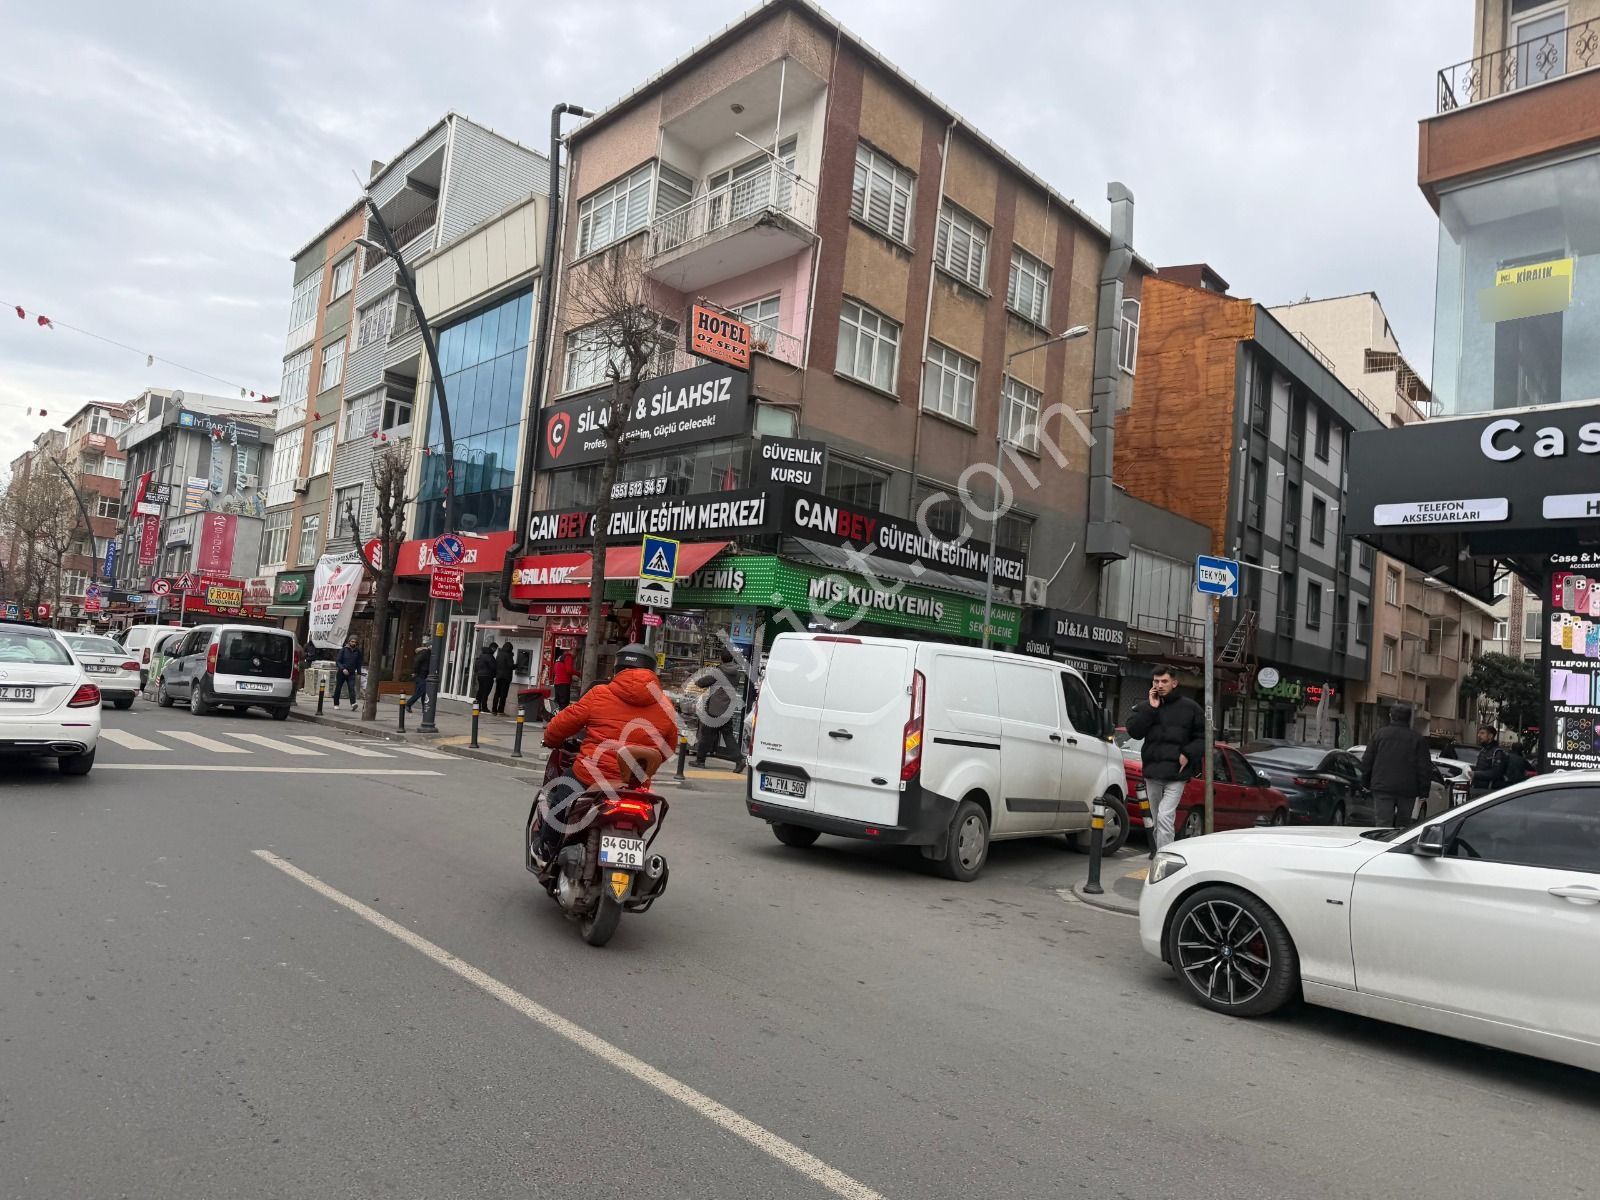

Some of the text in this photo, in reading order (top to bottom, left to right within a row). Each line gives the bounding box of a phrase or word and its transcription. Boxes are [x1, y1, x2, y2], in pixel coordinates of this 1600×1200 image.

[698, 312, 747, 345] HOTEL
[716, 340, 746, 356] SEFA
[635, 397, 647, 420] &
[650, 376, 732, 417] SİLAHSIZ
[653, 422, 677, 438] Güçlü
[678, 414, 716, 431] Gelecek!
[1480, 418, 1600, 461] Cas
[762, 444, 822, 466] GÜVENLİK
[770, 466, 812, 485] KURSU
[628, 480, 644, 498] 512
[656, 477, 668, 495] 57
[1417, 501, 1465, 513] TELEFON
[529, 512, 590, 541] CANBEY
[649, 501, 696, 533] EĞİTİM
[697, 492, 766, 530] MERKEZİ
[1401, 511, 1481, 524] AKSESUARLARI
[794, 498, 1023, 582] CANBEY GÜVENLİK EĞİTİM MRKEZİ
[1550, 553, 1578, 563] Case
[1580, 552, 1590, 562] &
[520, 567, 549, 585] GALA
[1200, 569, 1227, 582] TEK YÖN
[215, 590, 240, 602] ROMA
[639, 592, 670, 606] KASİS
[545, 604, 558, 614] GALA
[847, 587, 945, 623] KURUYEMİŞ
[969, 602, 1017, 623] KUR KAHVE
[1056, 618, 1124, 645] Dİ&LA SHOES
[1025, 639, 1051, 656] GÜVENLİK
[1550, 660, 1589, 668] TELEFON
[0, 687, 32, 698] Z 013
[1553, 705, 1585, 714] TABLET
[1547, 752, 1573, 760] EKRAN
[1550, 759, 1569, 767] LENS
[765, 776, 773, 788] 34
[791, 781, 804, 794] 506
[602, 837, 643, 852] 34 GUK
[616, 851, 636, 864] 216
